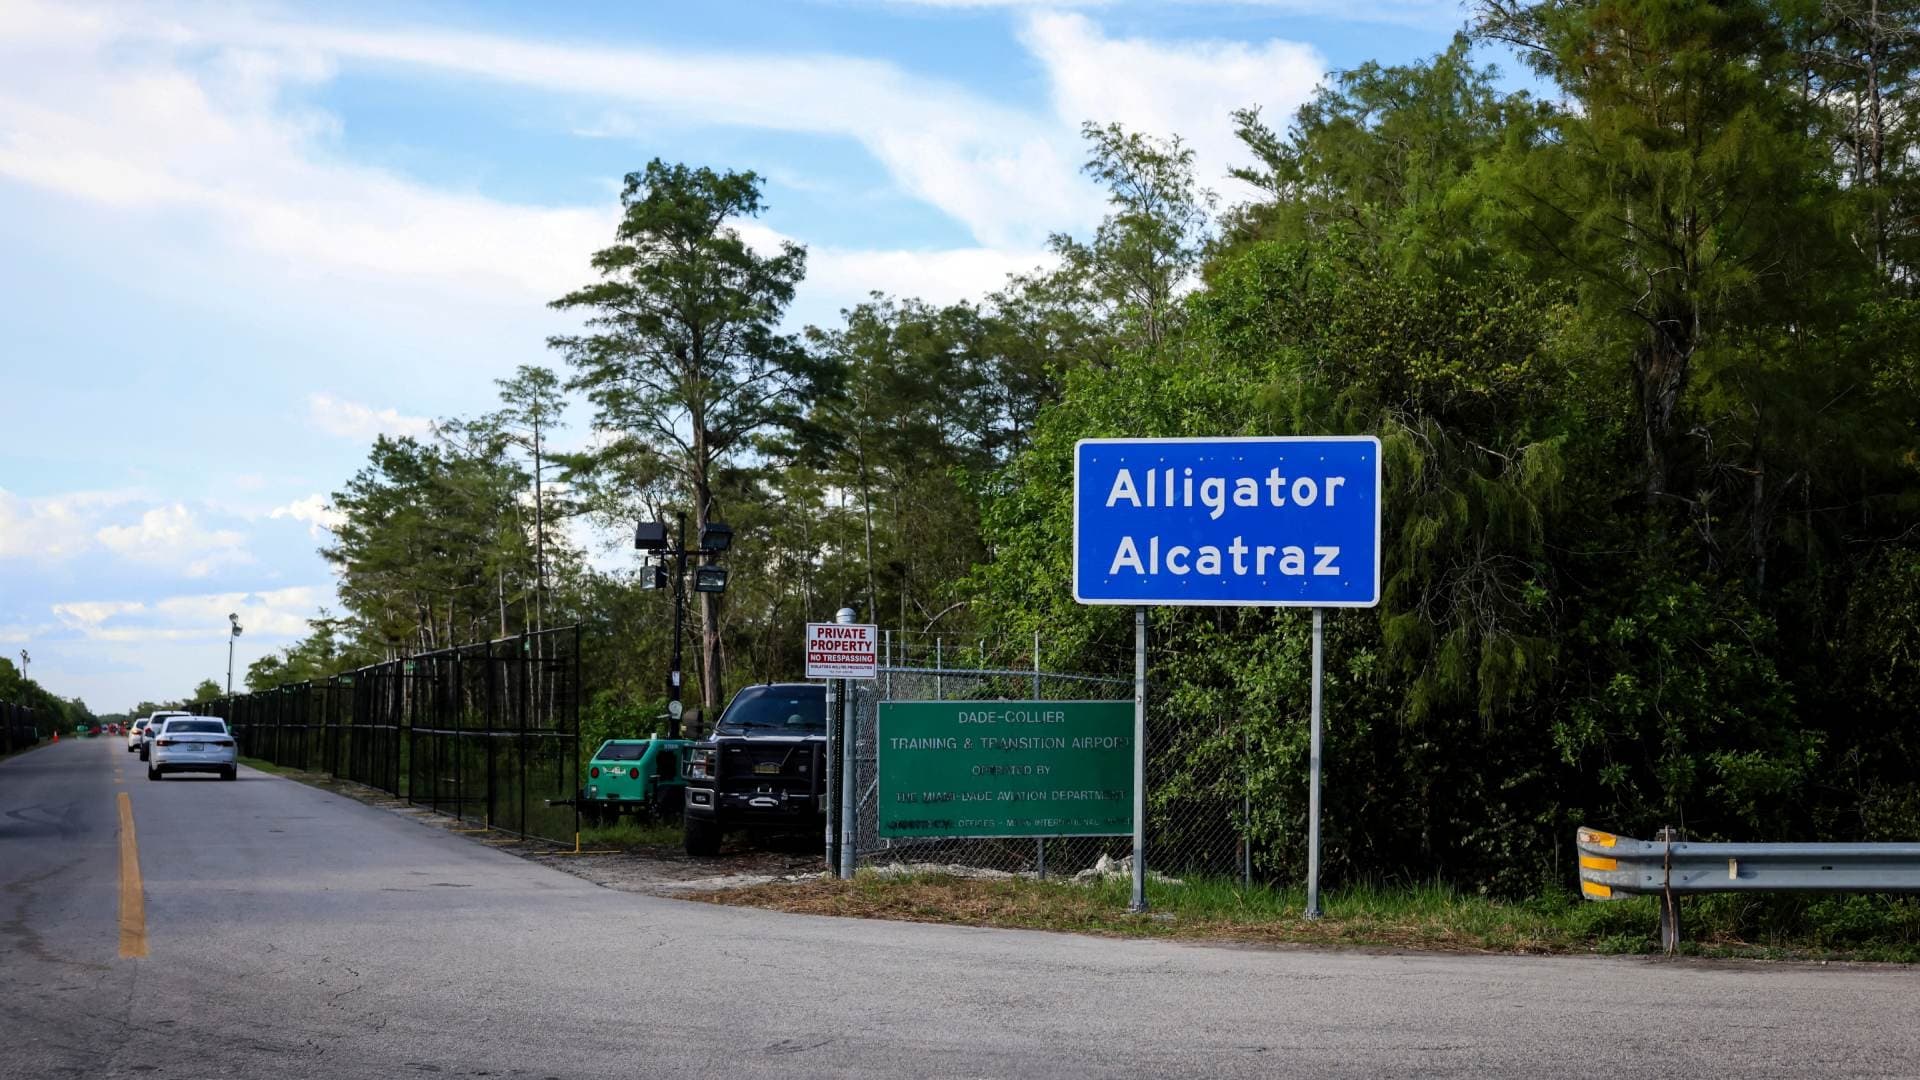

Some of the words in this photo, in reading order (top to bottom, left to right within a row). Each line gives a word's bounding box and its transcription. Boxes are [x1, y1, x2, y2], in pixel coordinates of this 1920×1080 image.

[1105, 466, 1346, 520] Alligator
[1108, 535, 1341, 576] Alcatraz
[817, 627, 867, 639] PRIVATE
[810, 639, 873, 652] PROPERTY
[822, 654, 873, 662] TRESPASSING
[958, 711, 1065, 723] DADE-COLLIER
[890, 737, 957, 750] TRAINING
[963, 737, 973, 749] &
[980, 737, 1065, 749] TRANSITION
[972, 765, 1032, 775] OPRATED
[1036, 765, 1051, 775] BY
[997, 790, 1047, 801] AVIATION
